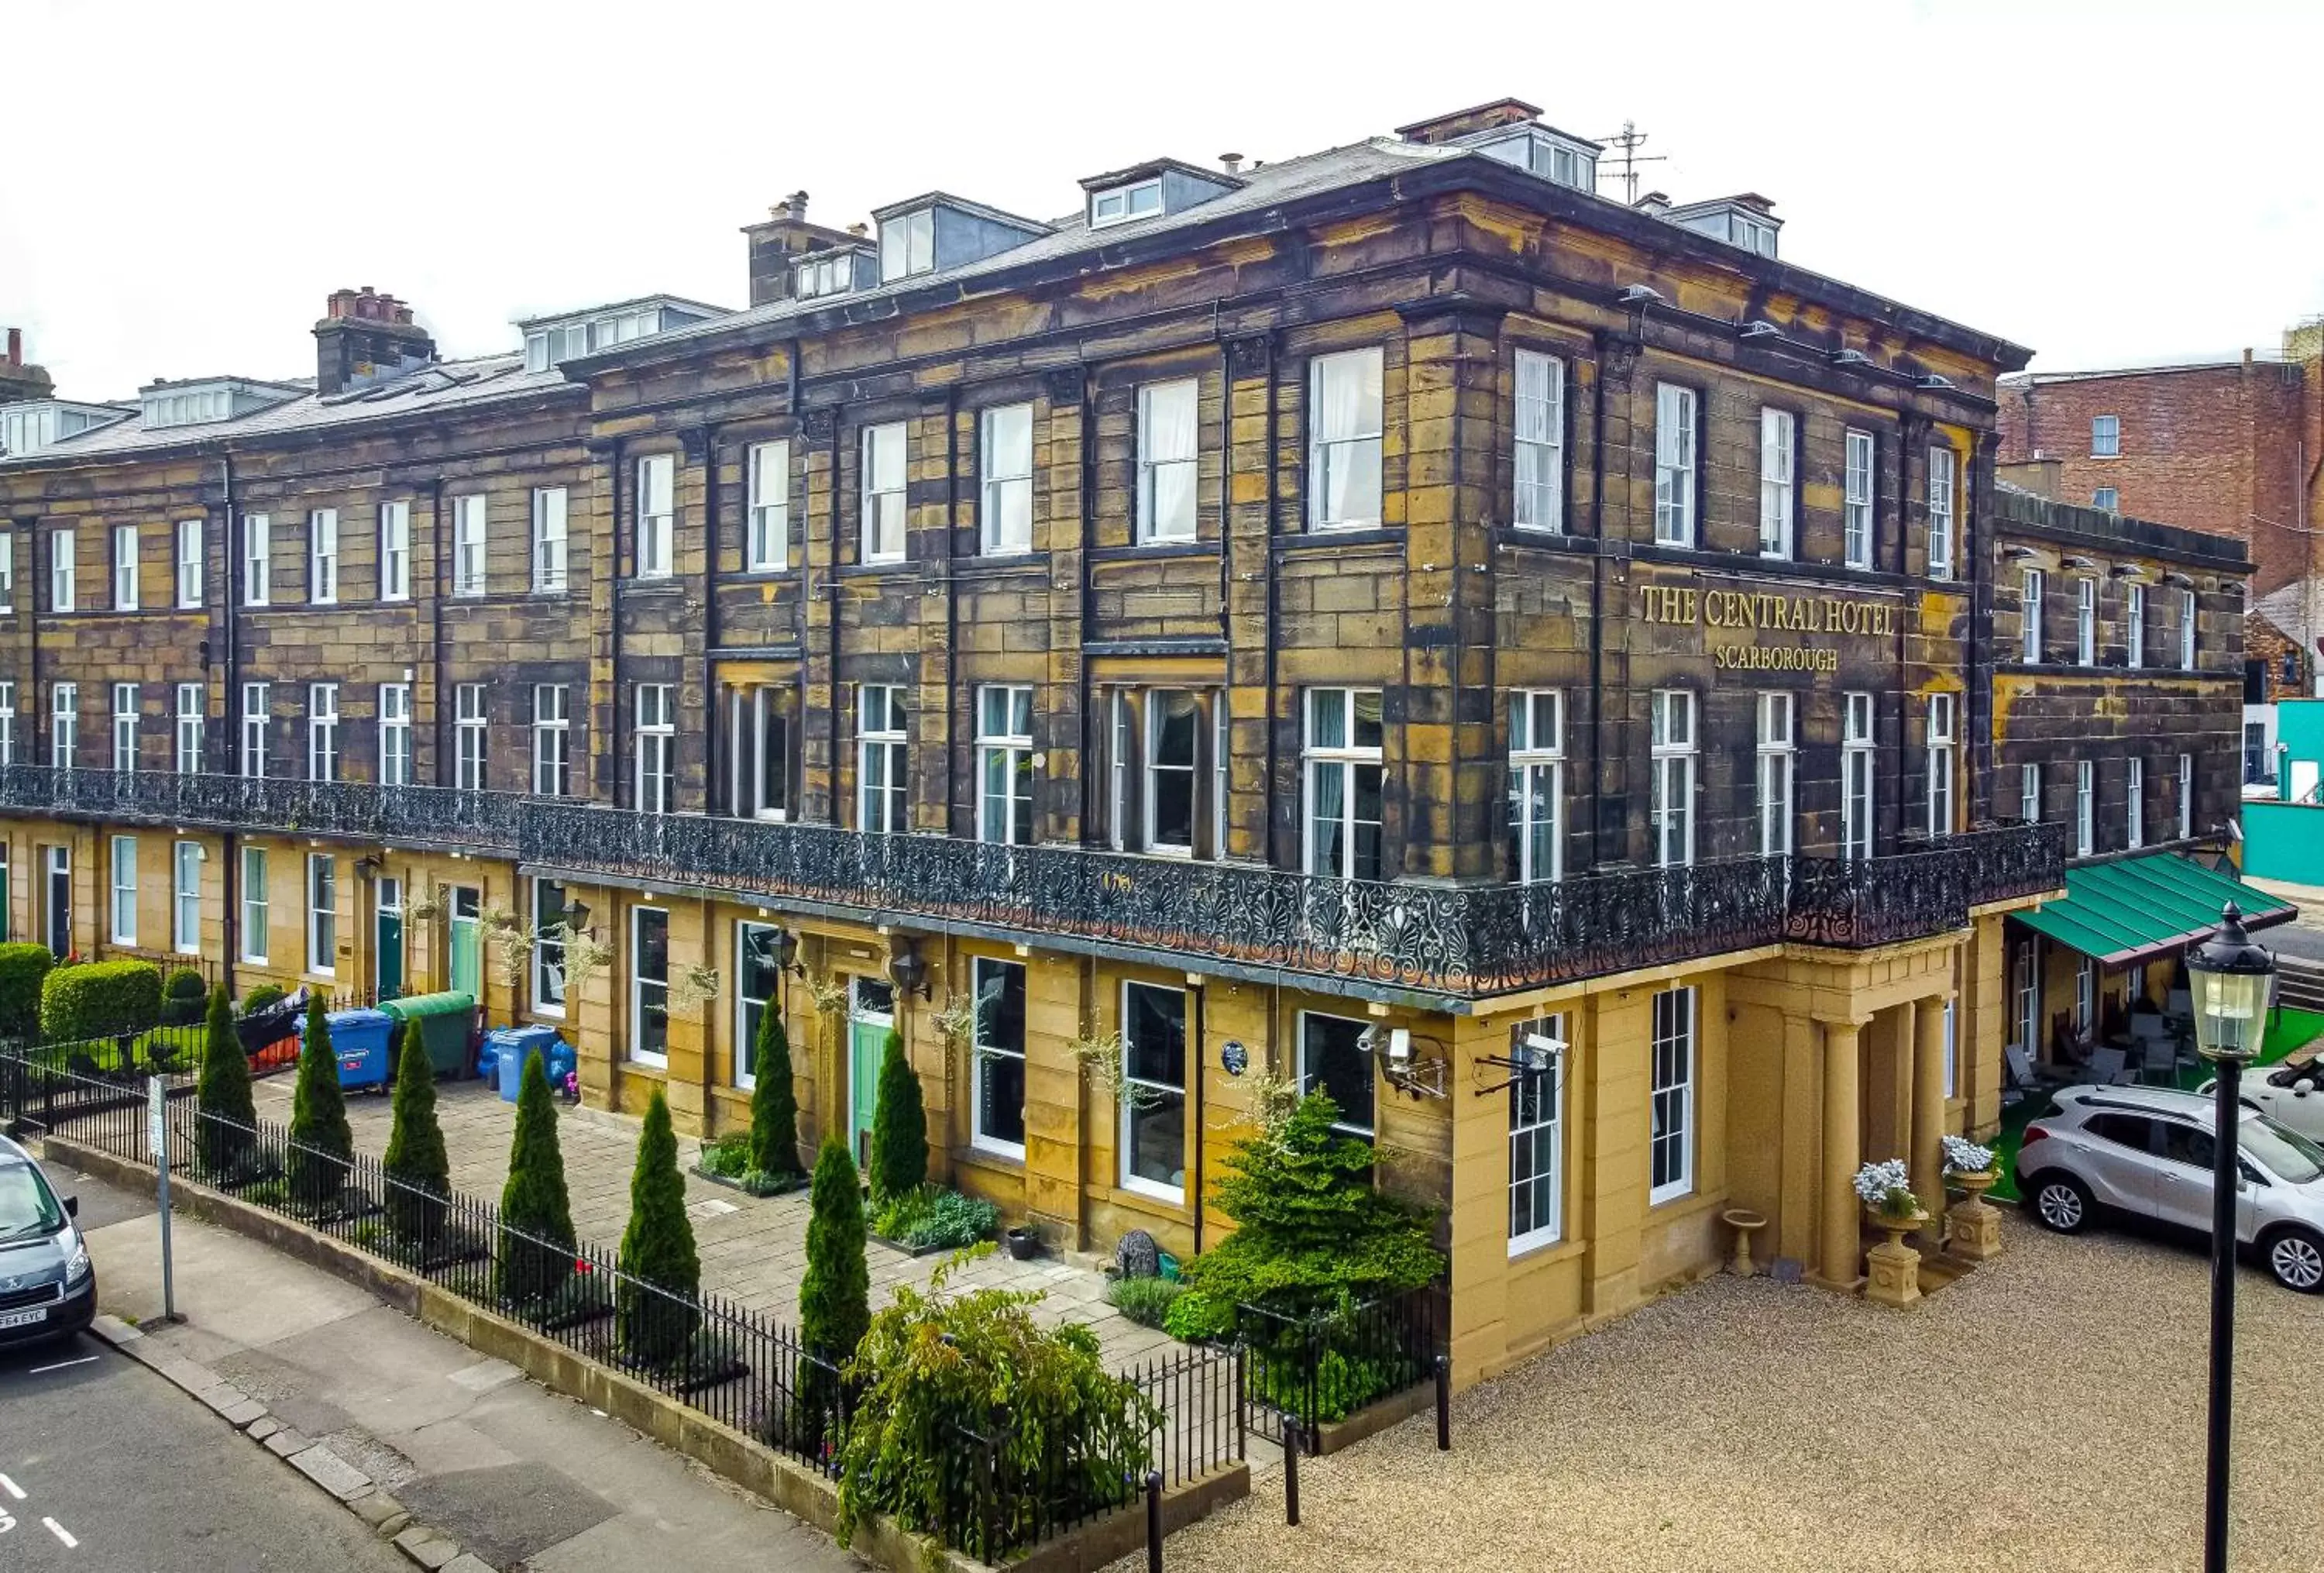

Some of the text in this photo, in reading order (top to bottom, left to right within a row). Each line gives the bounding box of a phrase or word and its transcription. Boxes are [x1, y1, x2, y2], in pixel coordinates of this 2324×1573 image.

[1640, 585, 1894, 635] THE CENTRAL HOTEL
[1714, 644, 1838, 671] SCARBOROUGH
